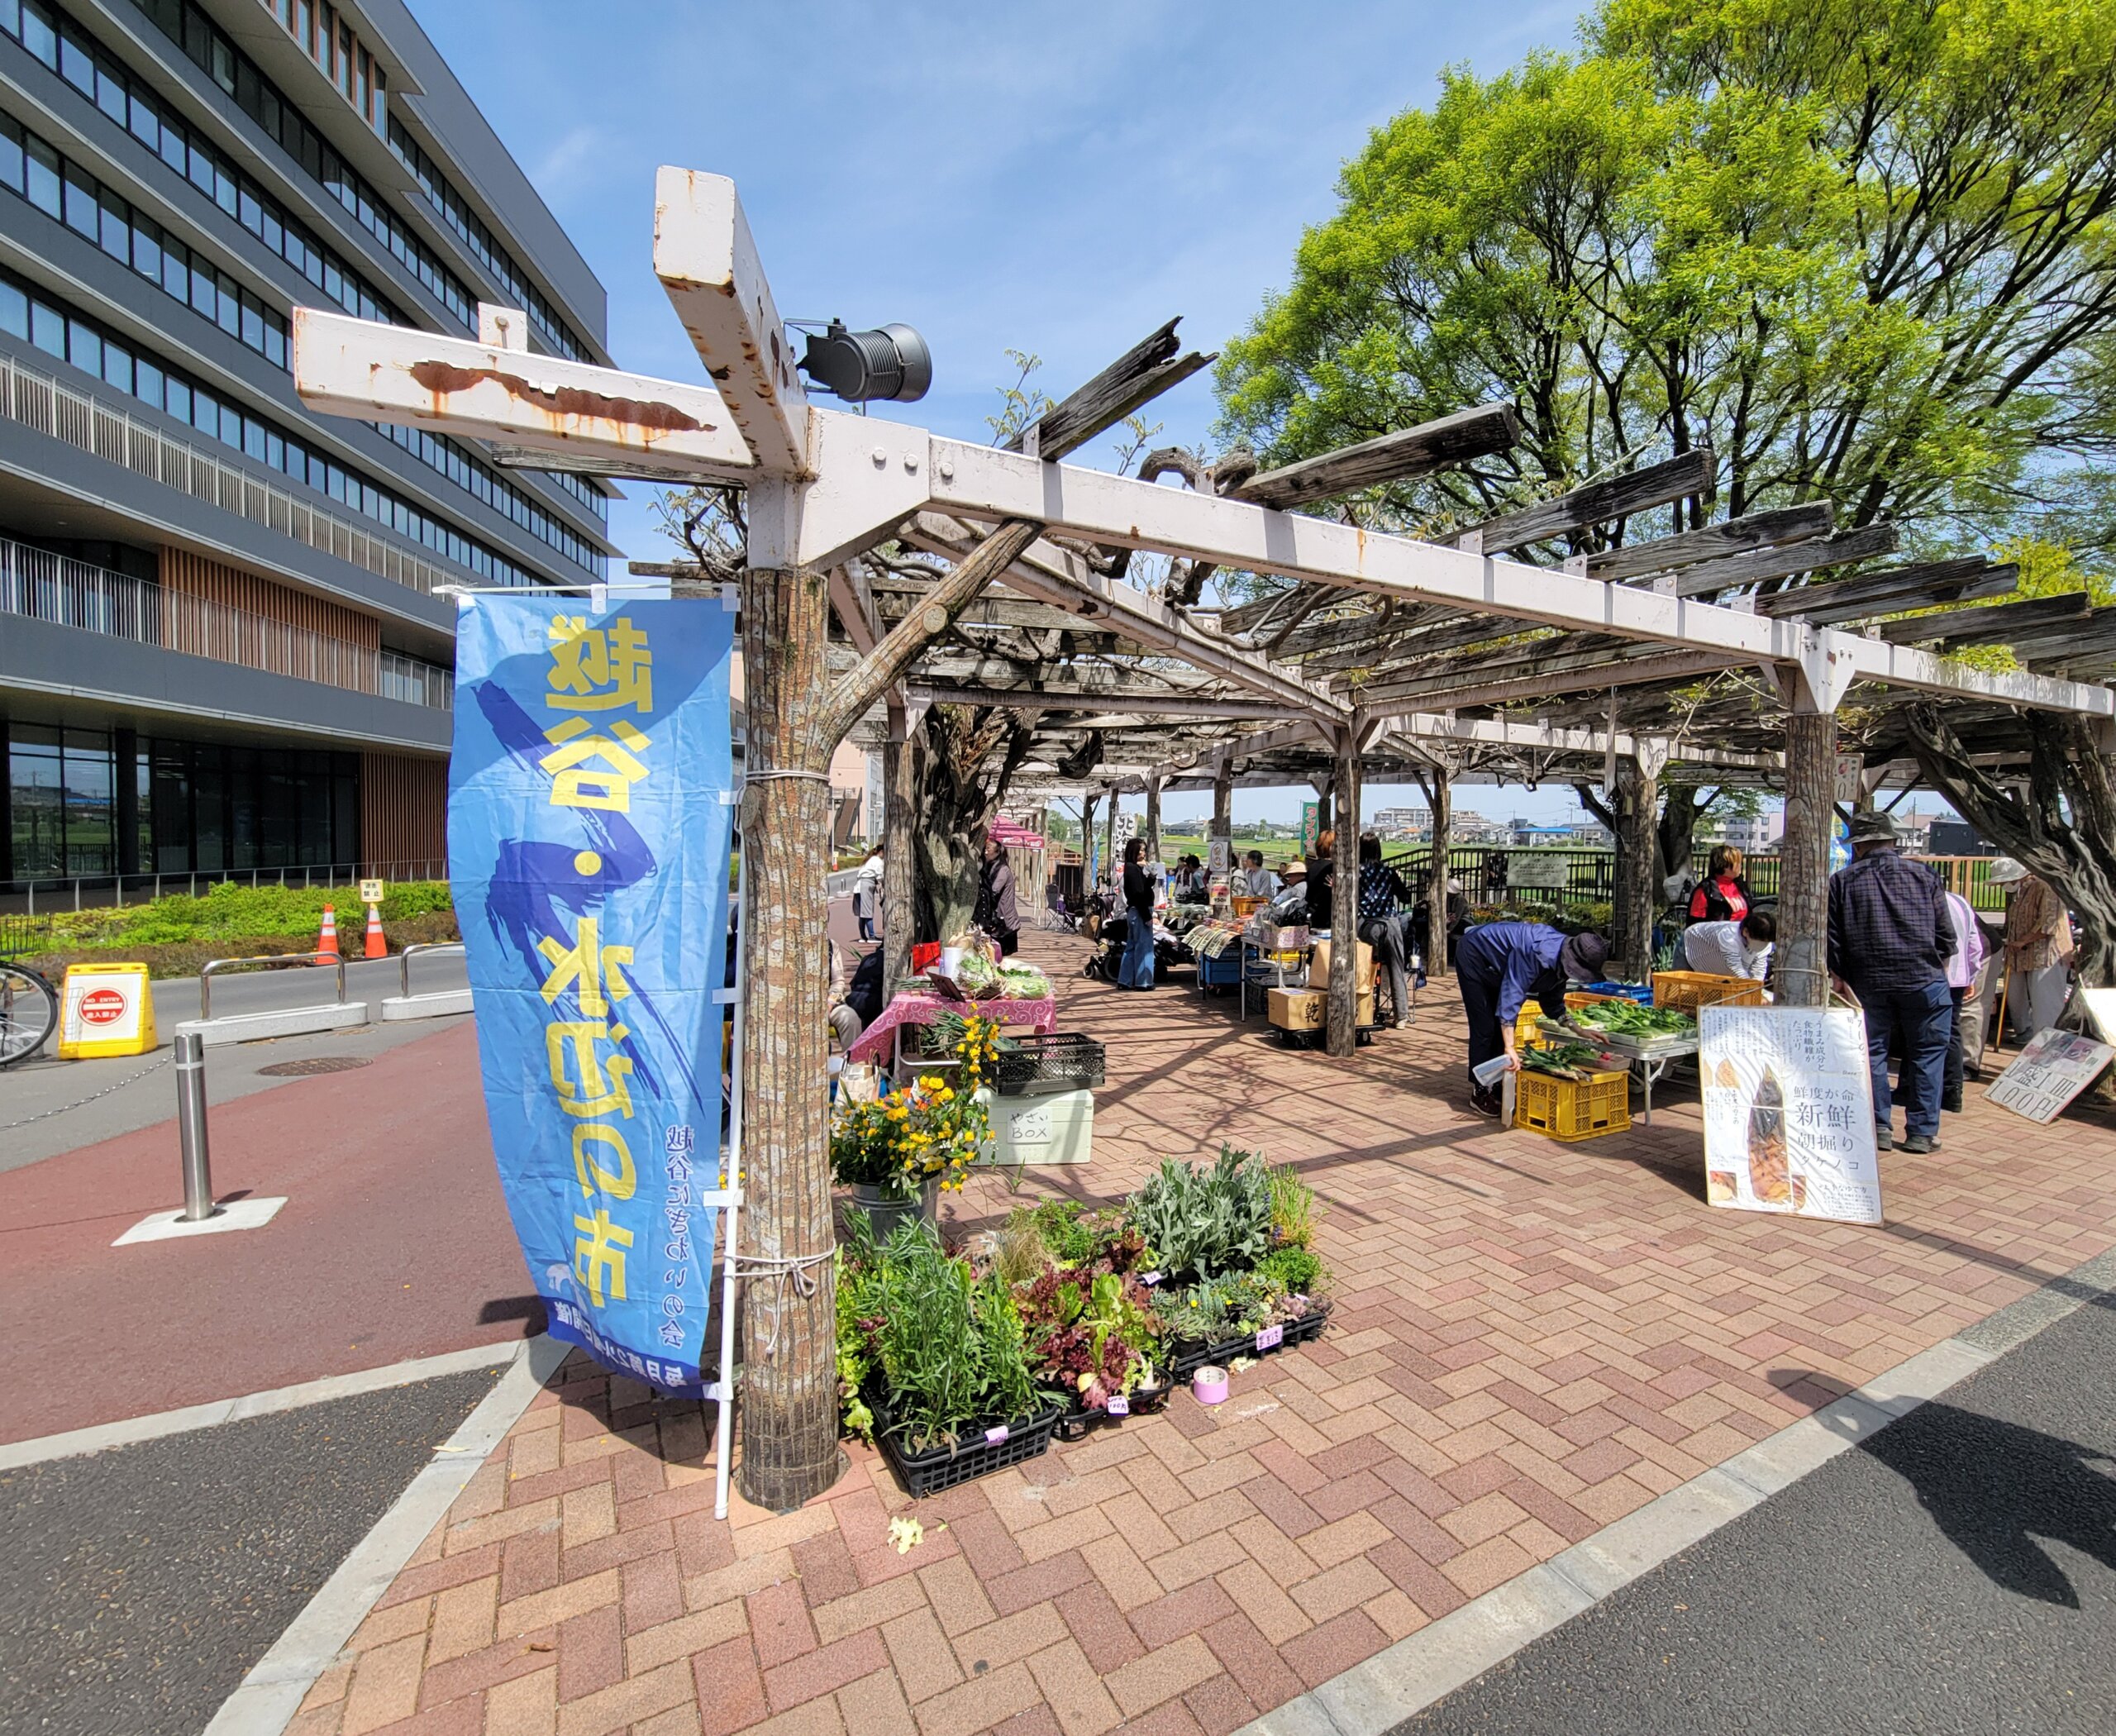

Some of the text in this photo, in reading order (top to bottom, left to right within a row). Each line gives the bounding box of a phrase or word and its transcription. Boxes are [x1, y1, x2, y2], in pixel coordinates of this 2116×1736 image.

[1794, 1085, 1854, 1101] 鮮度が命
[1986, 1081, 2061, 1120] 100円
[1010, 1113, 1048, 1124] やさい
[1795, 1102, 1856, 1130] 新鮮
[1012, 1127, 1047, 1138] BOX
[1798, 1133, 1853, 1152] 朝掘り
[1802, 1156, 1859, 1170] タケノコ
